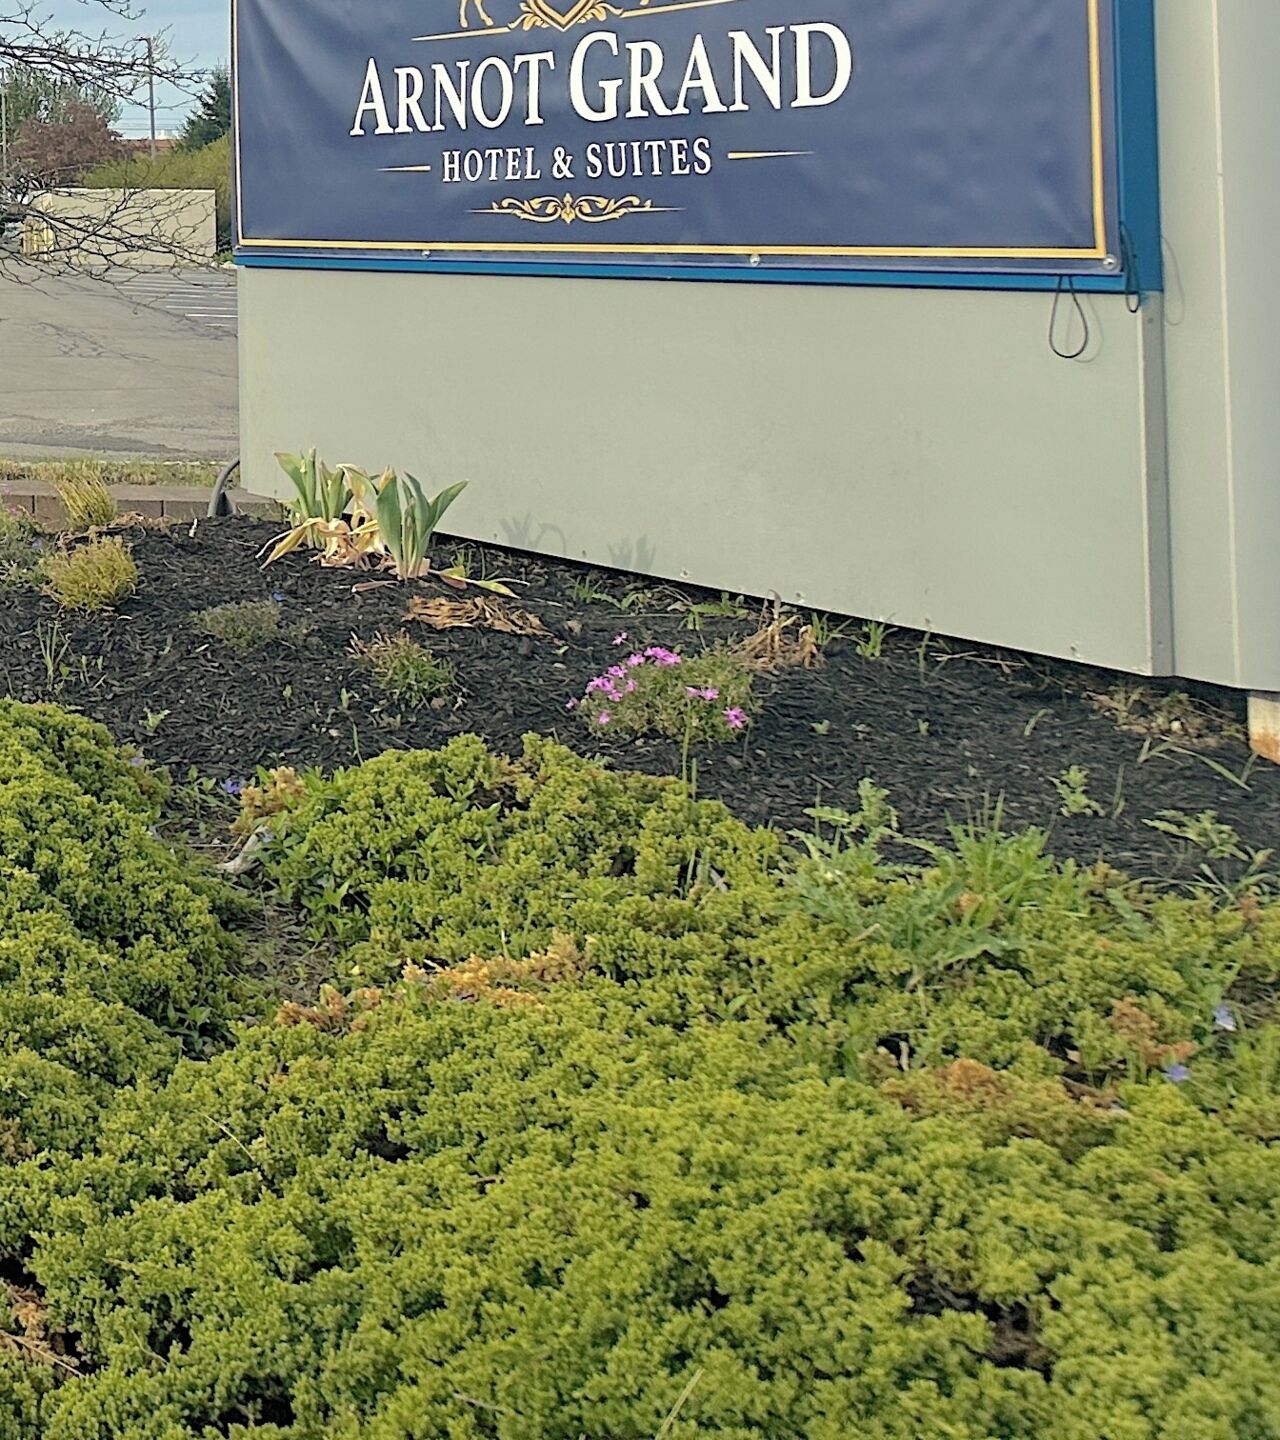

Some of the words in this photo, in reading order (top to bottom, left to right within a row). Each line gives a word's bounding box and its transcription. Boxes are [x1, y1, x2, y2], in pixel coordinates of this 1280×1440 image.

[348, 50, 556, 137] ARNOT
[569, 21, 854, 123] GRAND
[441, 147, 542, 183] HOTEL
[552, 147, 575, 179] &
[586, 137, 713, 177] SUITES
